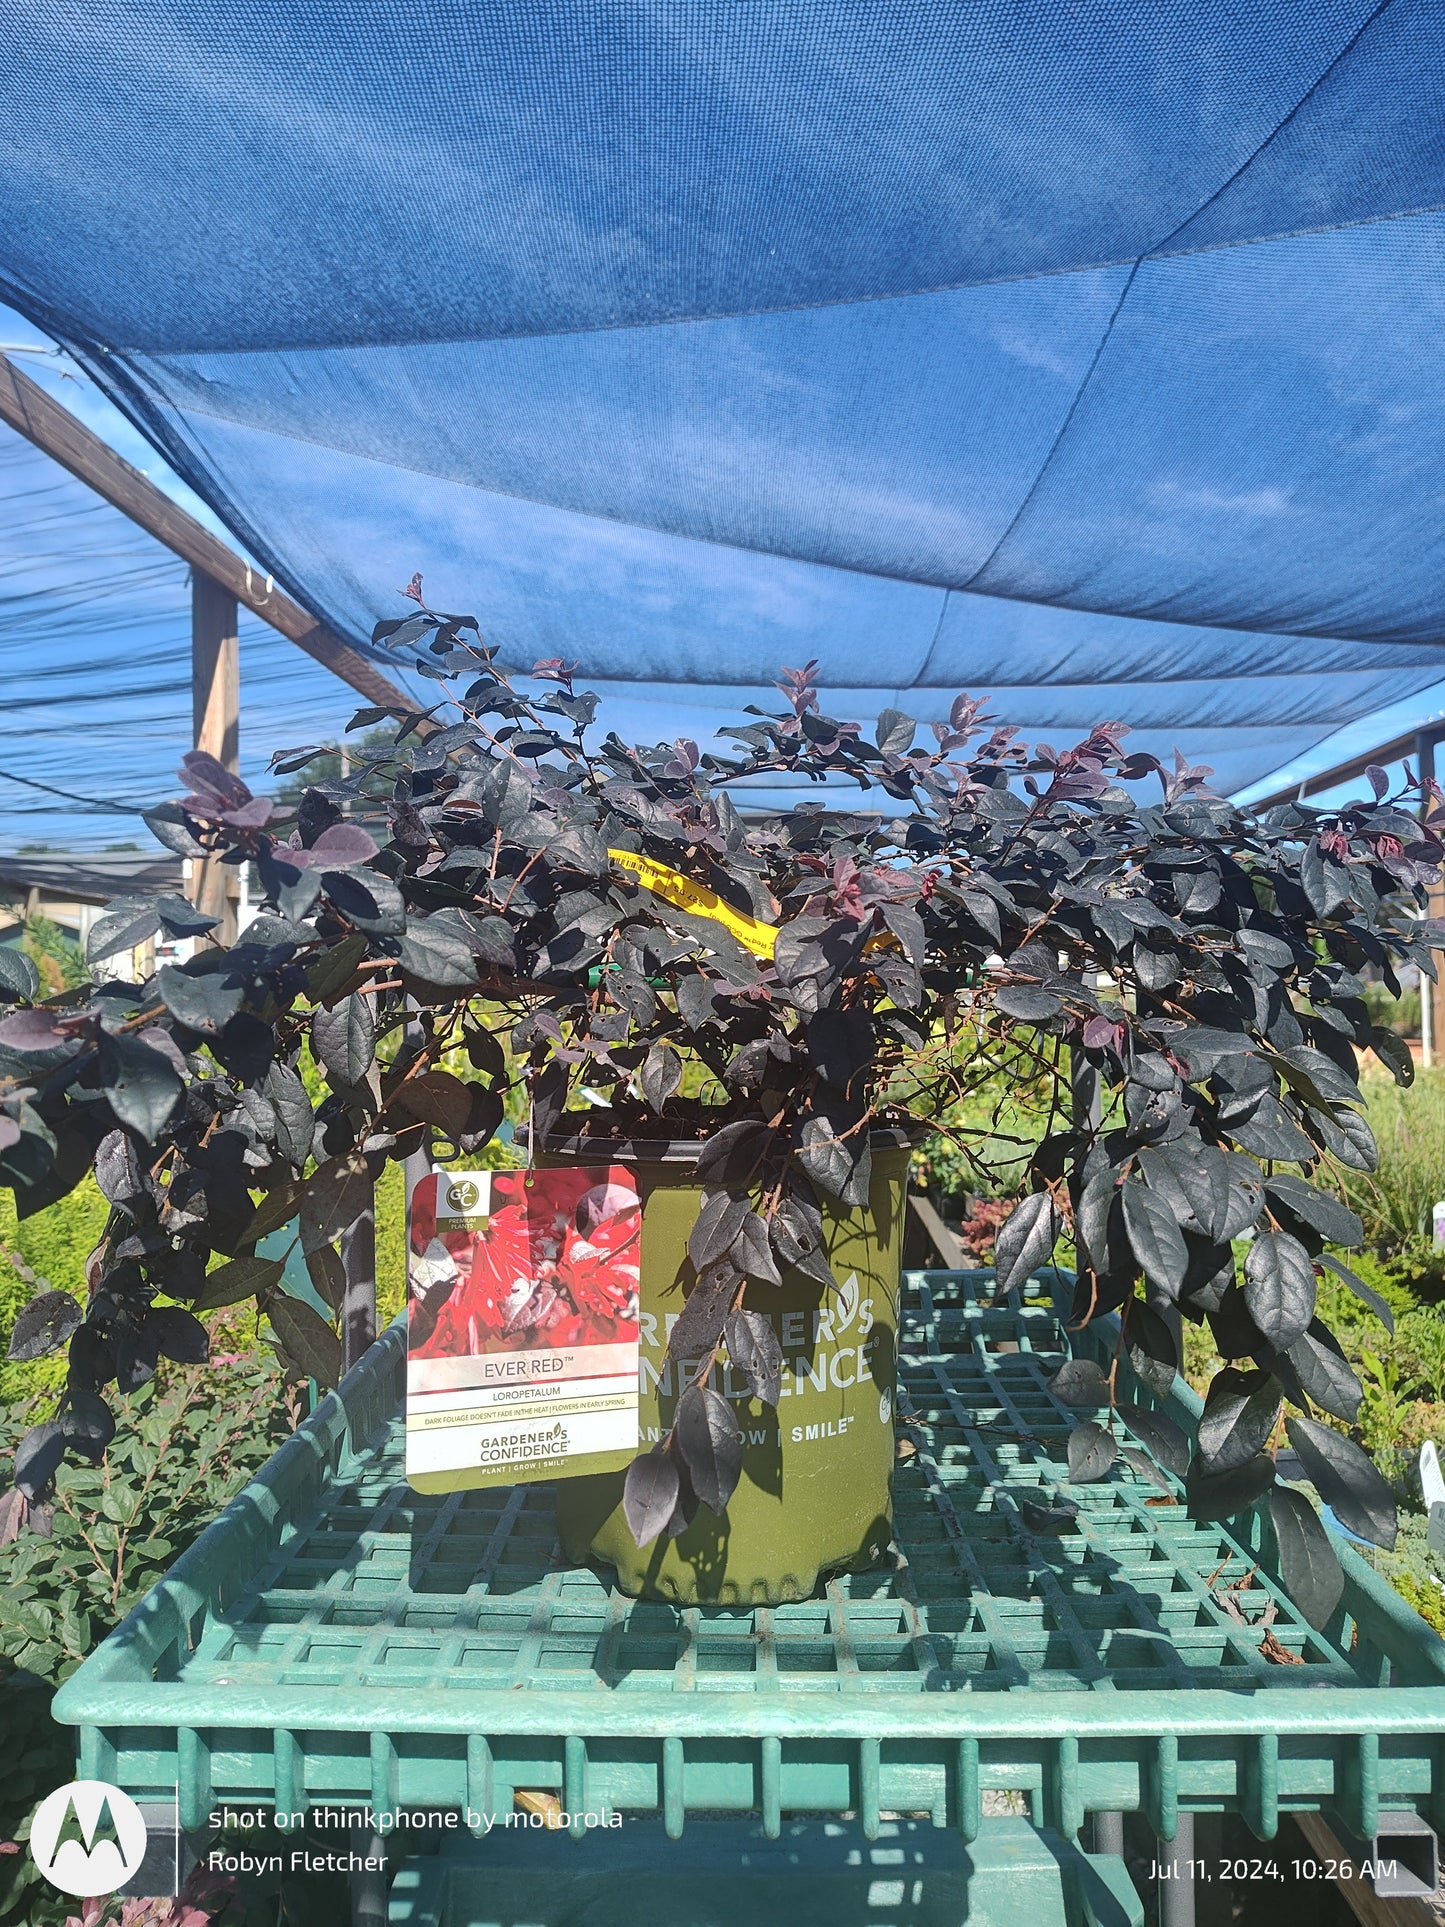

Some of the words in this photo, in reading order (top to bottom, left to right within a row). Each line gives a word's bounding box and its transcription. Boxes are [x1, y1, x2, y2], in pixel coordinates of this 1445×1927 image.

[484, 1361, 526, 1378] EVER
[493, 1386, 561, 1401] LOROPETALUM
[443, 1414, 469, 1423] FOLIAGE
[470, 1411, 496, 1421] DOESN'T
[497, 1409, 513, 1417] FADE
[521, 1407, 533, 1415] THE
[533, 1406, 549, 1414] HEAT
[552, 1403, 579, 1412] FLOWERS
[587, 1400, 604, 1408] EARLY
[604, 1398, 625, 1407] SPRING
[481, 1424, 568, 1449] GARDENER'S
[481, 1466, 506, 1475] PLANT
[513, 1462, 537, 1471] GROW
